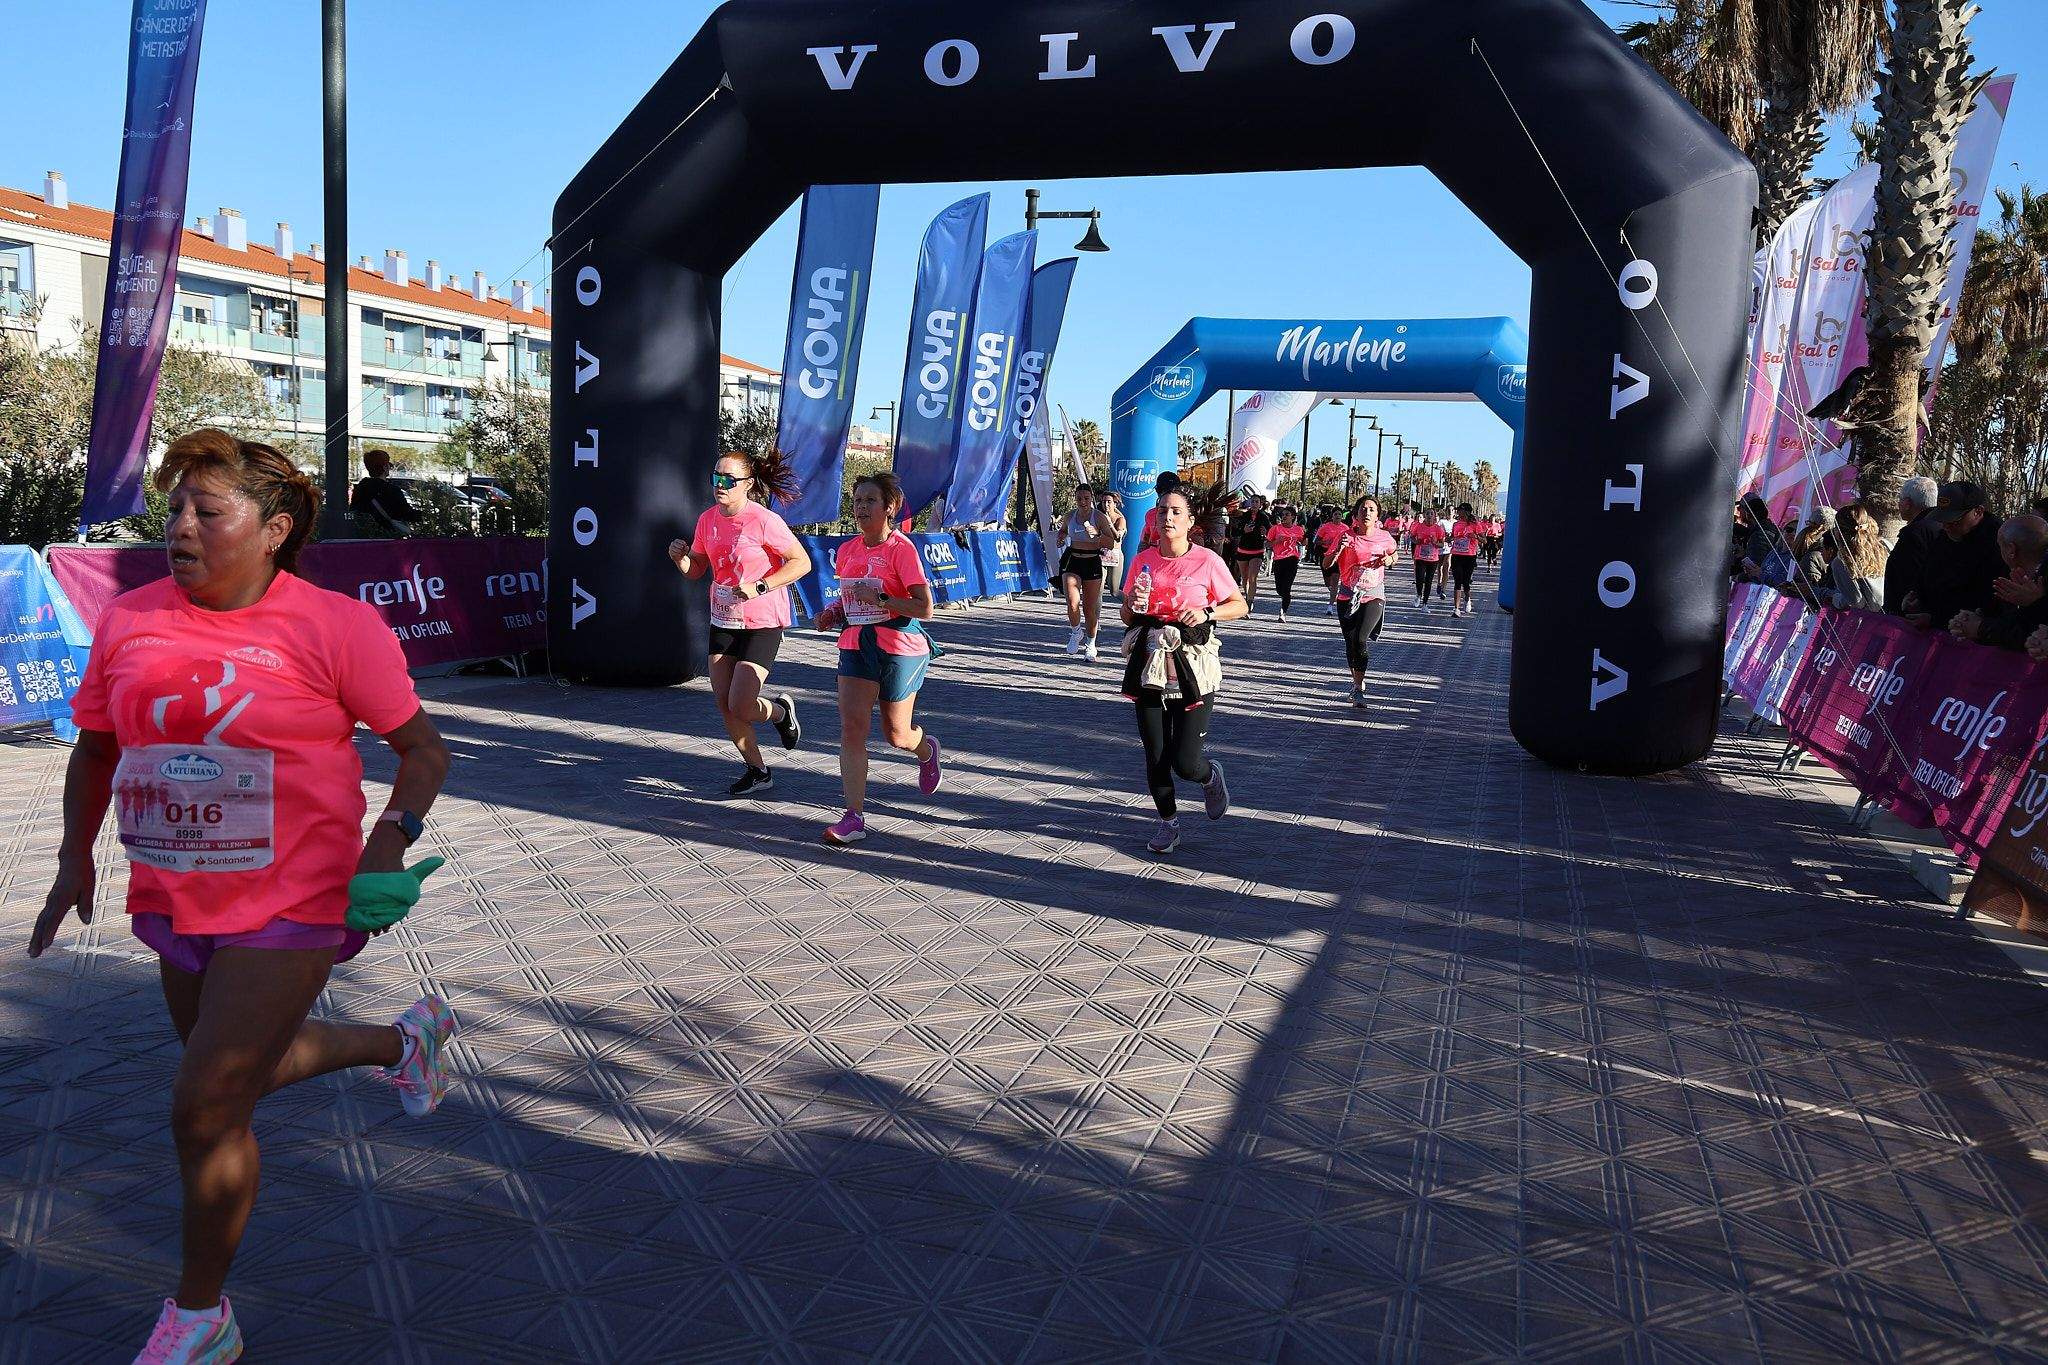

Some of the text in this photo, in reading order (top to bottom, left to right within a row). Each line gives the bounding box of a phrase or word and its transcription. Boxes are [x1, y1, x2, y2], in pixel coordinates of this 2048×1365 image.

[135, 14, 176, 33] CÁNCER
[806, 13, 1356, 90] VOLVO
[145, 260, 157, 273] AL
[1810, 256, 1840, 272] Sal
[1775, 276, 1799, 289] Sal
[799, 266, 847, 399] GOYA
[1276, 325, 1407, 381] Marlene
[1761, 351, 1784, 364] Sal
[1796, 343, 1823, 358] Sal
[916, 309, 956, 419] GOYA
[967, 331, 1005, 431] GOYA
[1153, 373, 1191, 391] Marlene
[1013, 350, 1045, 441] GOYA
[572, 265, 602, 630] VOLVO
[1118, 469, 1156, 488] Marlene
[1590, 259, 1658, 711] VOLVO
[924, 542, 955, 566] GOYA
[359, 563, 446, 615] renfe
[411, 620, 454, 638] OFICIAL
[503, 612, 533, 630] TREN
[1849, 655, 1906, 716] renfe
[1835, 714, 1873, 750] TREN OFICIAL
[1930, 690, 2007, 761] renfe
[164, 763, 219, 776] ASTURIANA
[1913, 757, 1965, 800] TREN OFICIAL
[165, 802, 223, 824] 016
[134, 837, 164, 847] CARRERA
[165, 840, 174, 848] DE
[175, 841, 184, 849] LA
[186, 841, 211, 849] MUJER
[217, 841, 252, 849] VALENCIA
[175, 829, 203, 839] 8998
[208, 855, 255, 865] Santander
